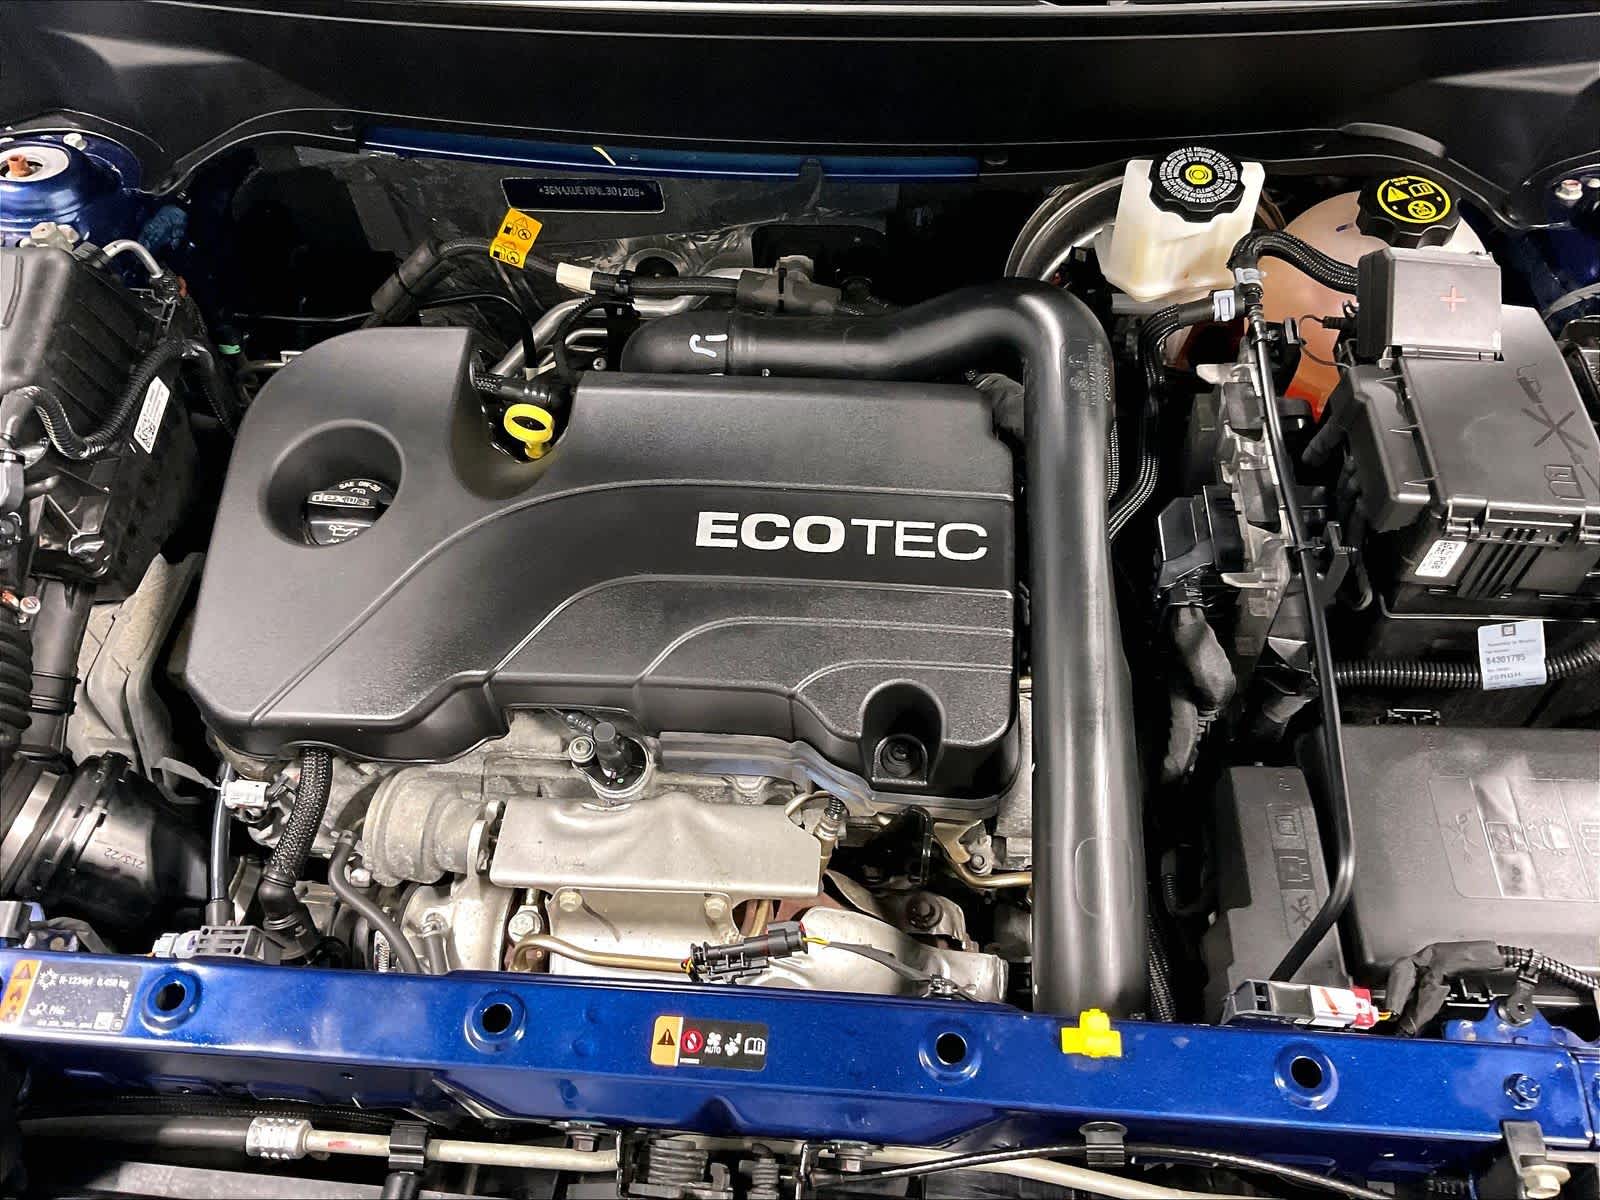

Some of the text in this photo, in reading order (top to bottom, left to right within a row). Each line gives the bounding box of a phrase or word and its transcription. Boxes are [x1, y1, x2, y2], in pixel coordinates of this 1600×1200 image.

[339, 481, 355, 490] SAE
[695, 511, 988, 561] ECOTEC
[704, 1046, 722, 1055] AUTO
